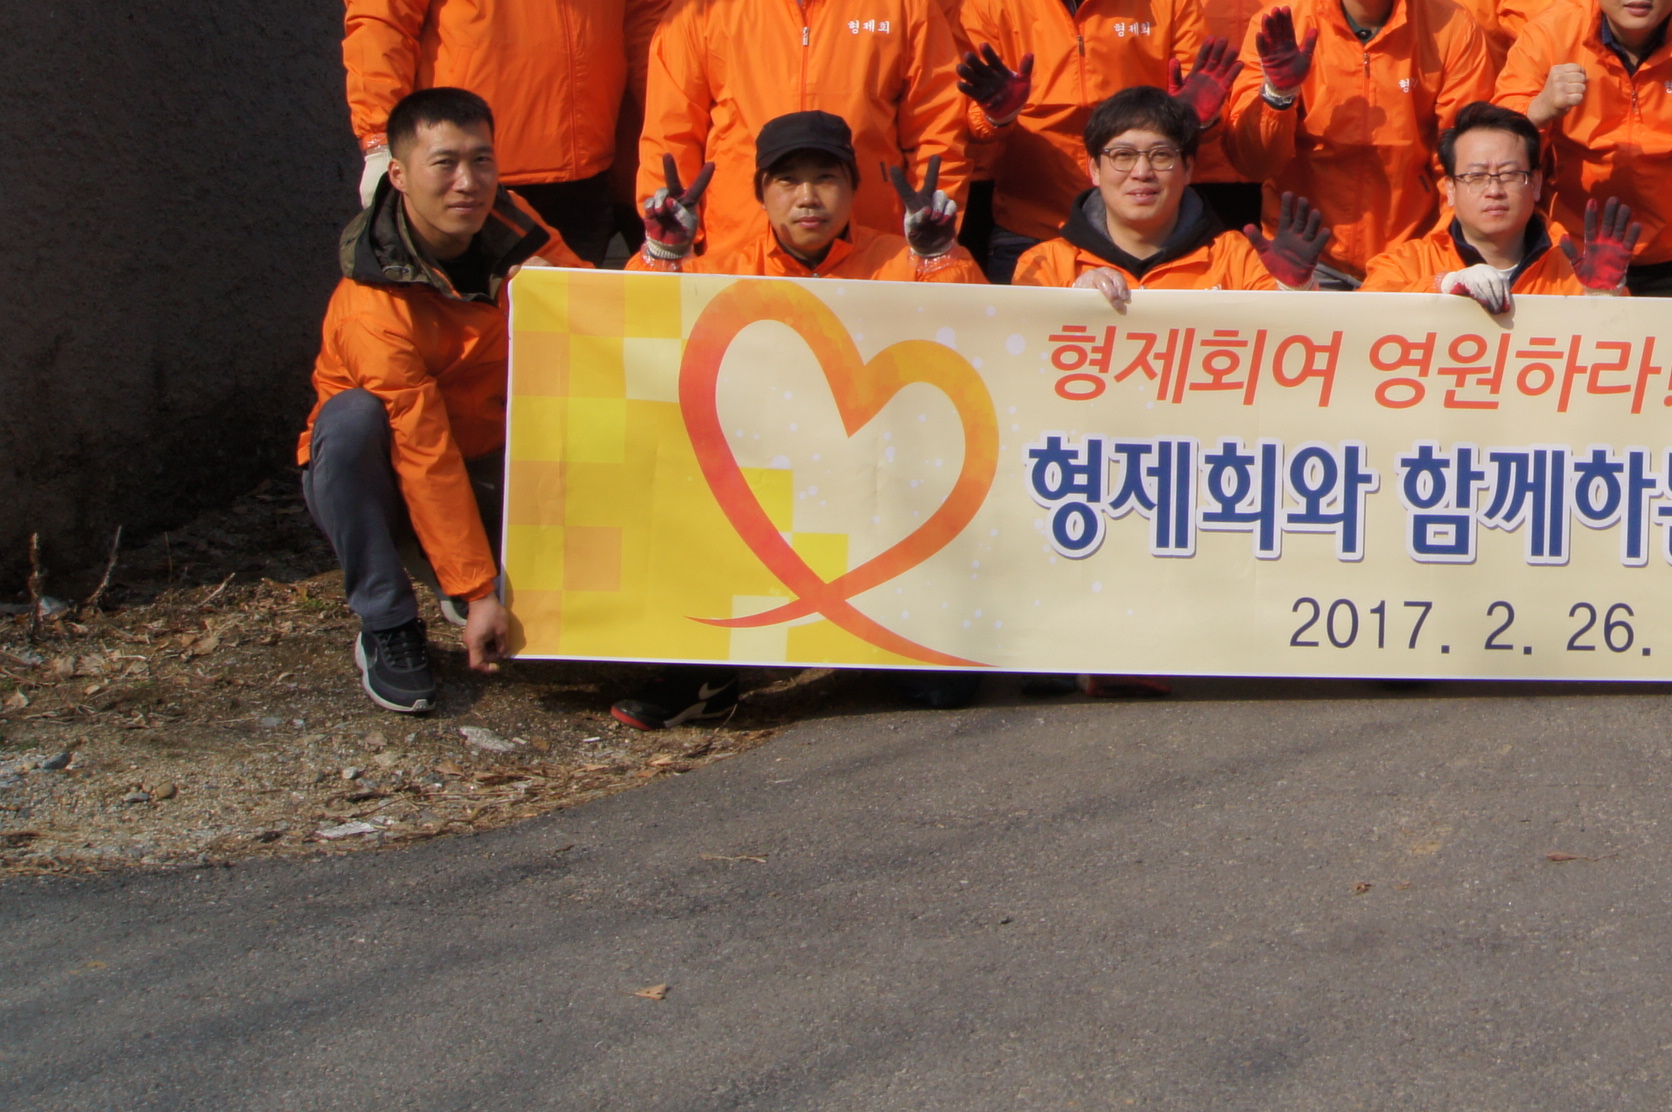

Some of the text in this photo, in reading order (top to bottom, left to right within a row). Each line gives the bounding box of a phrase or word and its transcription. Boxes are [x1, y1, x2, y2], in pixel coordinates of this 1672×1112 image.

[847, 19, 890, 35] 형제회
[1113, 22, 1151, 37] 형제회
[1048, 324, 1344, 408] 형제회여
[1027, 434, 1376, 557] 형제회와
[1288, 596, 1653, 658] 2017. 2. 26.
